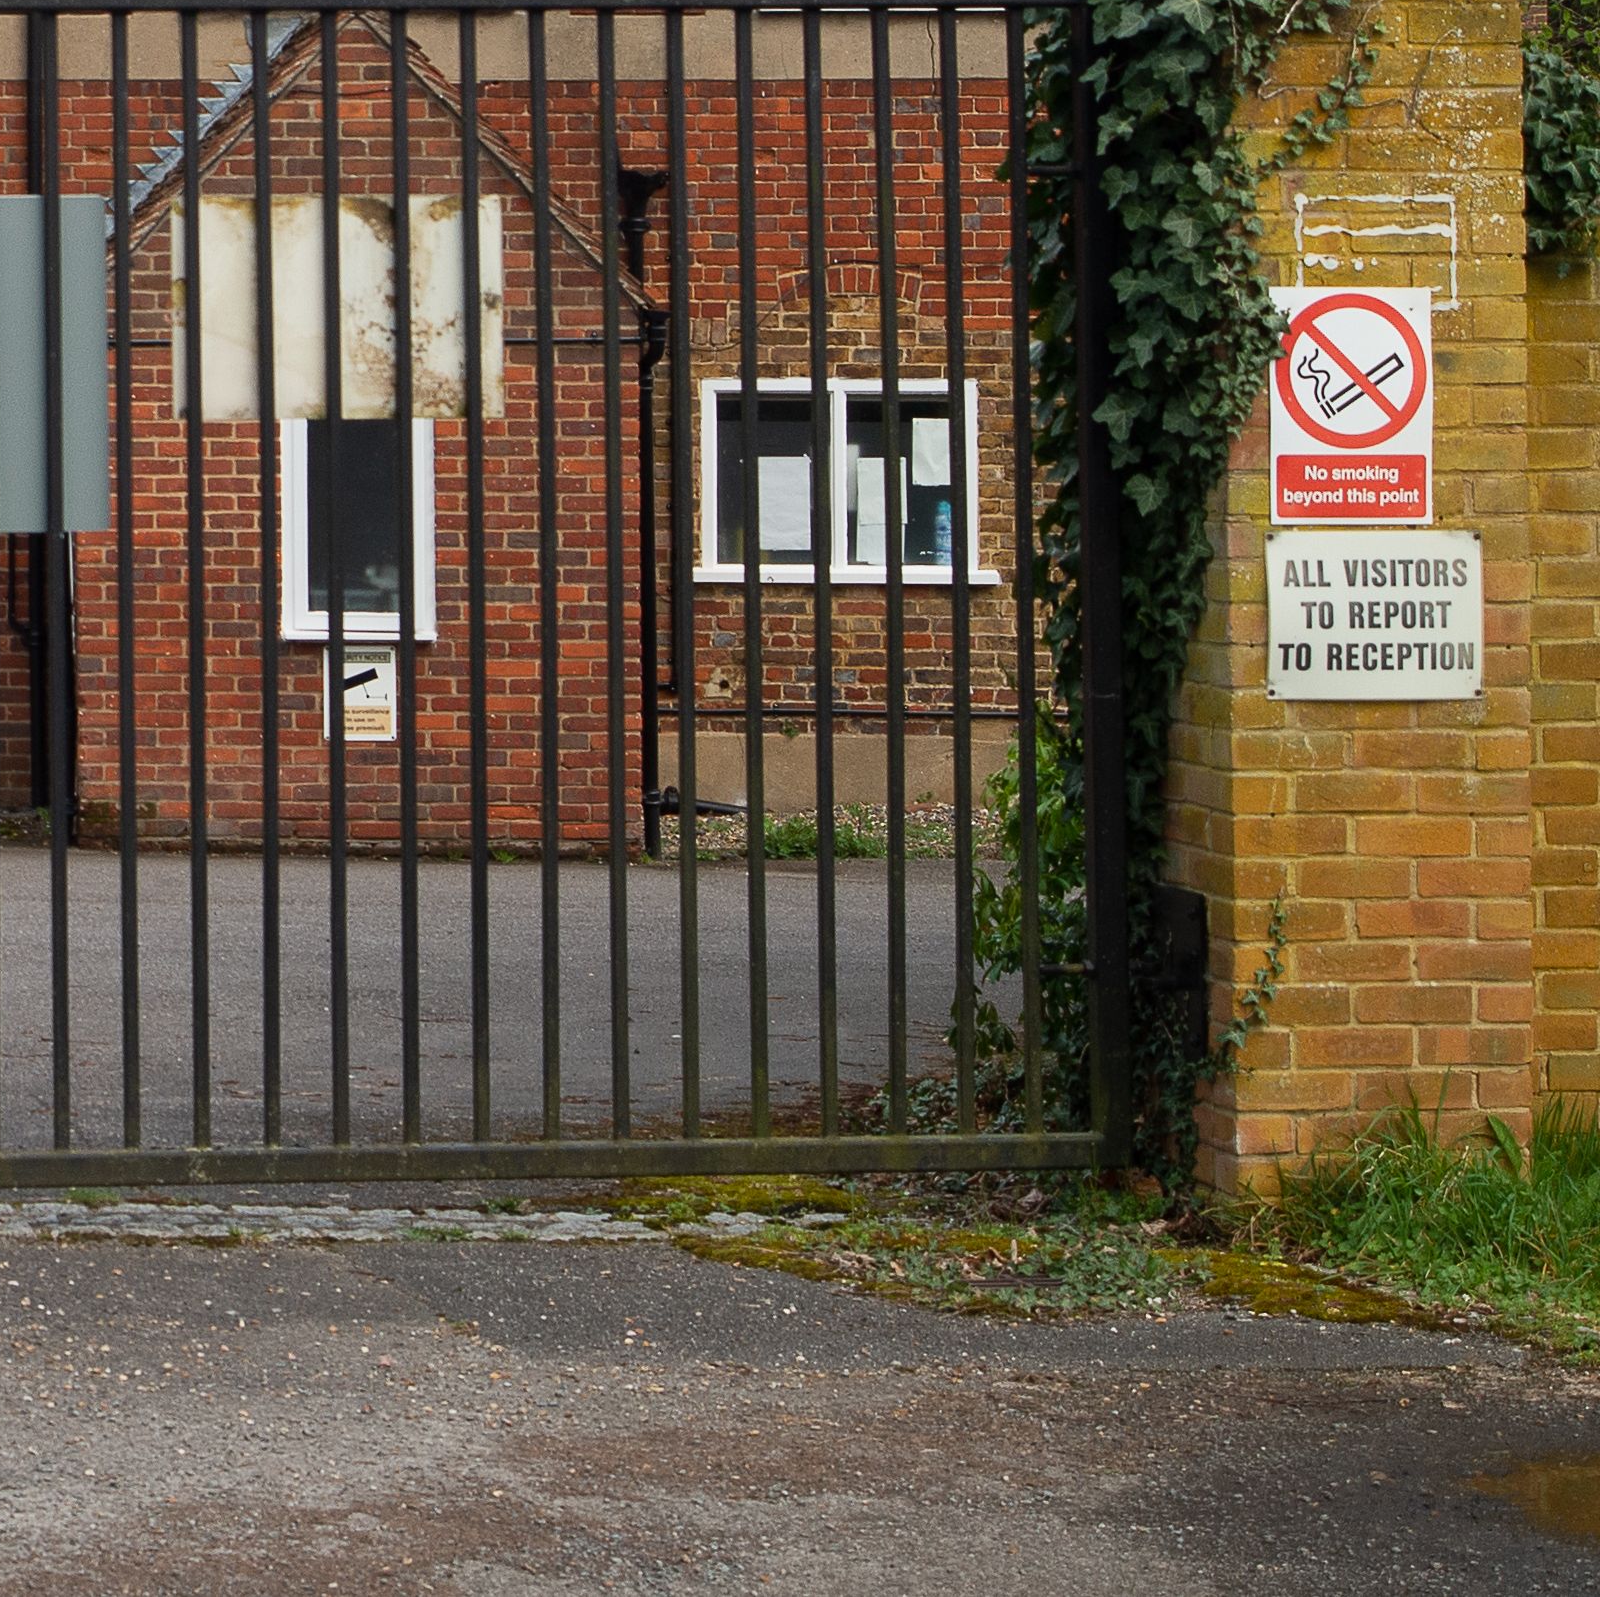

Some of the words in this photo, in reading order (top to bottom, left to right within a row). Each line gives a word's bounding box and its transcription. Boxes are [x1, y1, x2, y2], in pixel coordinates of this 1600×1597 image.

[1304, 465, 1328, 483] No
[1331, 465, 1399, 485] smoking
[1283, 488, 1342, 508] beyond
[1346, 488, 1376, 504] this
[1379, 488, 1419, 508] point
[1283, 559, 1331, 588] ALL
[1343, 559, 1468, 588] VISITORS
[1300, 601, 1334, 630] TO
[1349, 601, 1452, 630] REPORT
[1278, 643, 1312, 672] TO
[1326, 643, 1474, 671] RECEPTION
